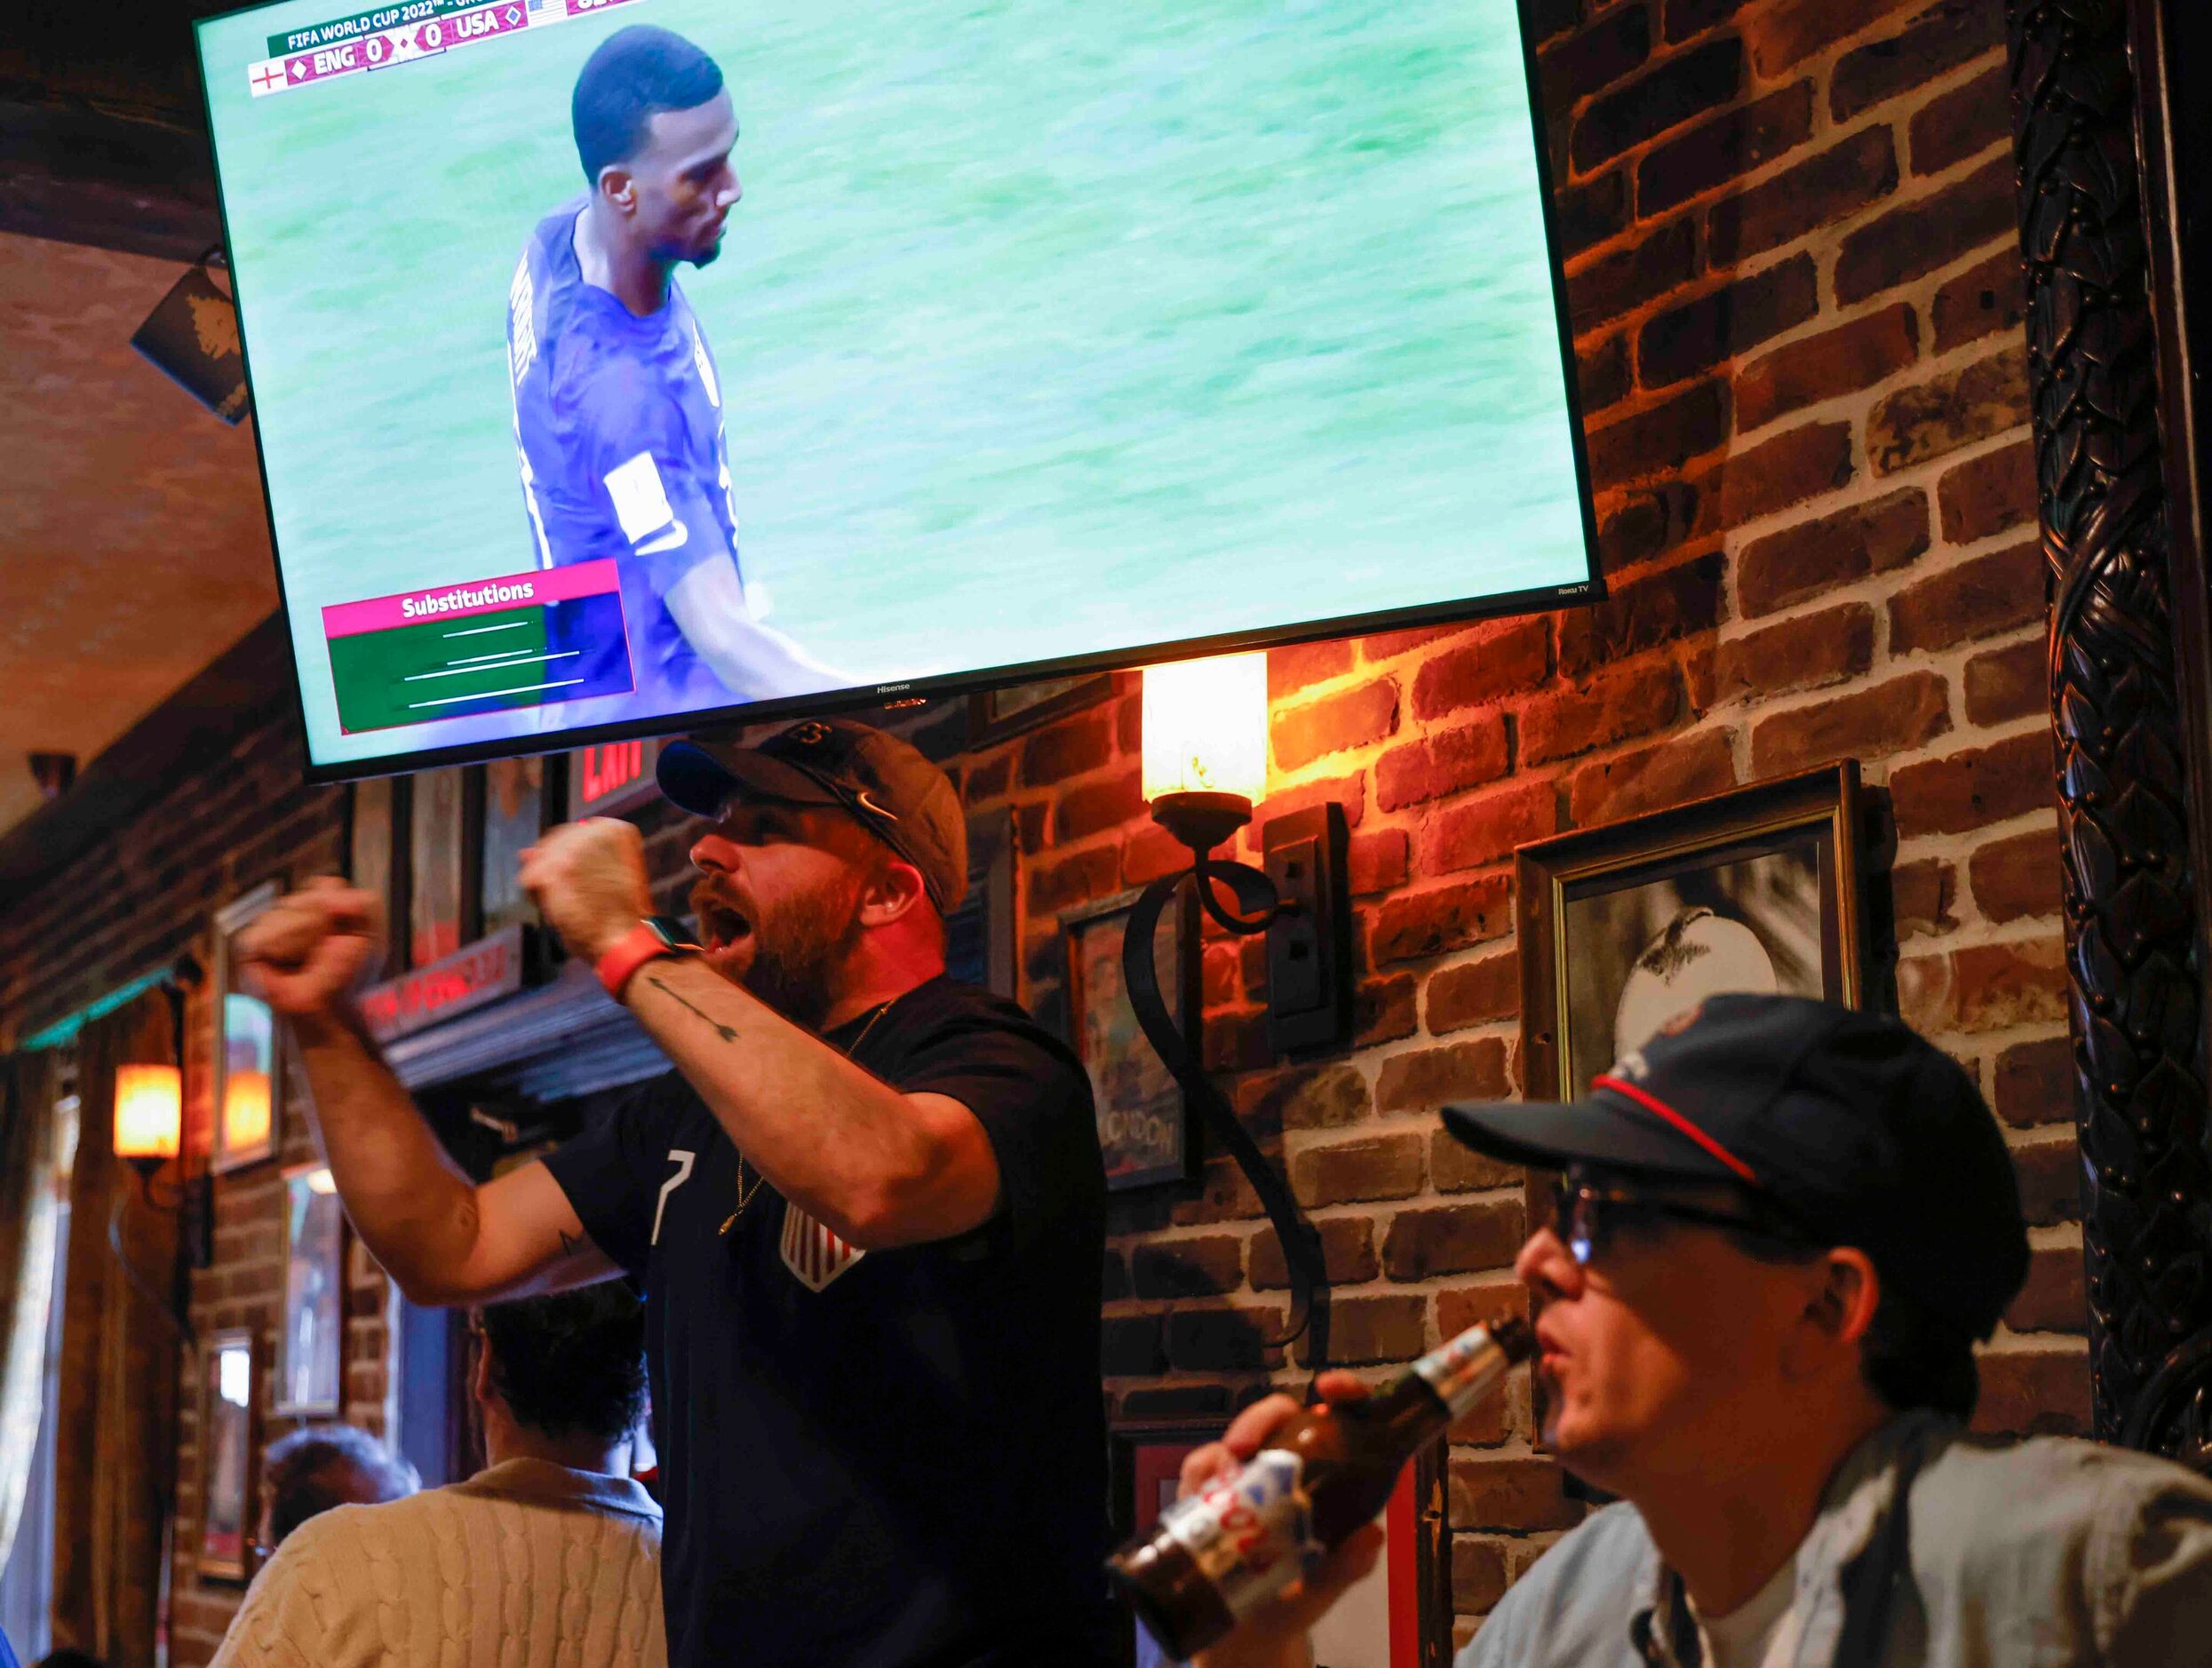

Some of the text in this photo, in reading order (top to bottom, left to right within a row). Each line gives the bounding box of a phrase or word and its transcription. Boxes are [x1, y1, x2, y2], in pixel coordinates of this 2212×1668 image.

[288, 29, 320, 51] FIFA
[320, 16, 371, 41] WORLD
[372, 9, 400, 27] CUP
[314, 10, 499, 75] ENG 0 0 USA
[402, 582, 534, 619] Substitutions
[1578, 584, 1589, 593] TV
[877, 683, 911, 695] Hisense
[651, 1149, 696, 1246] 7
